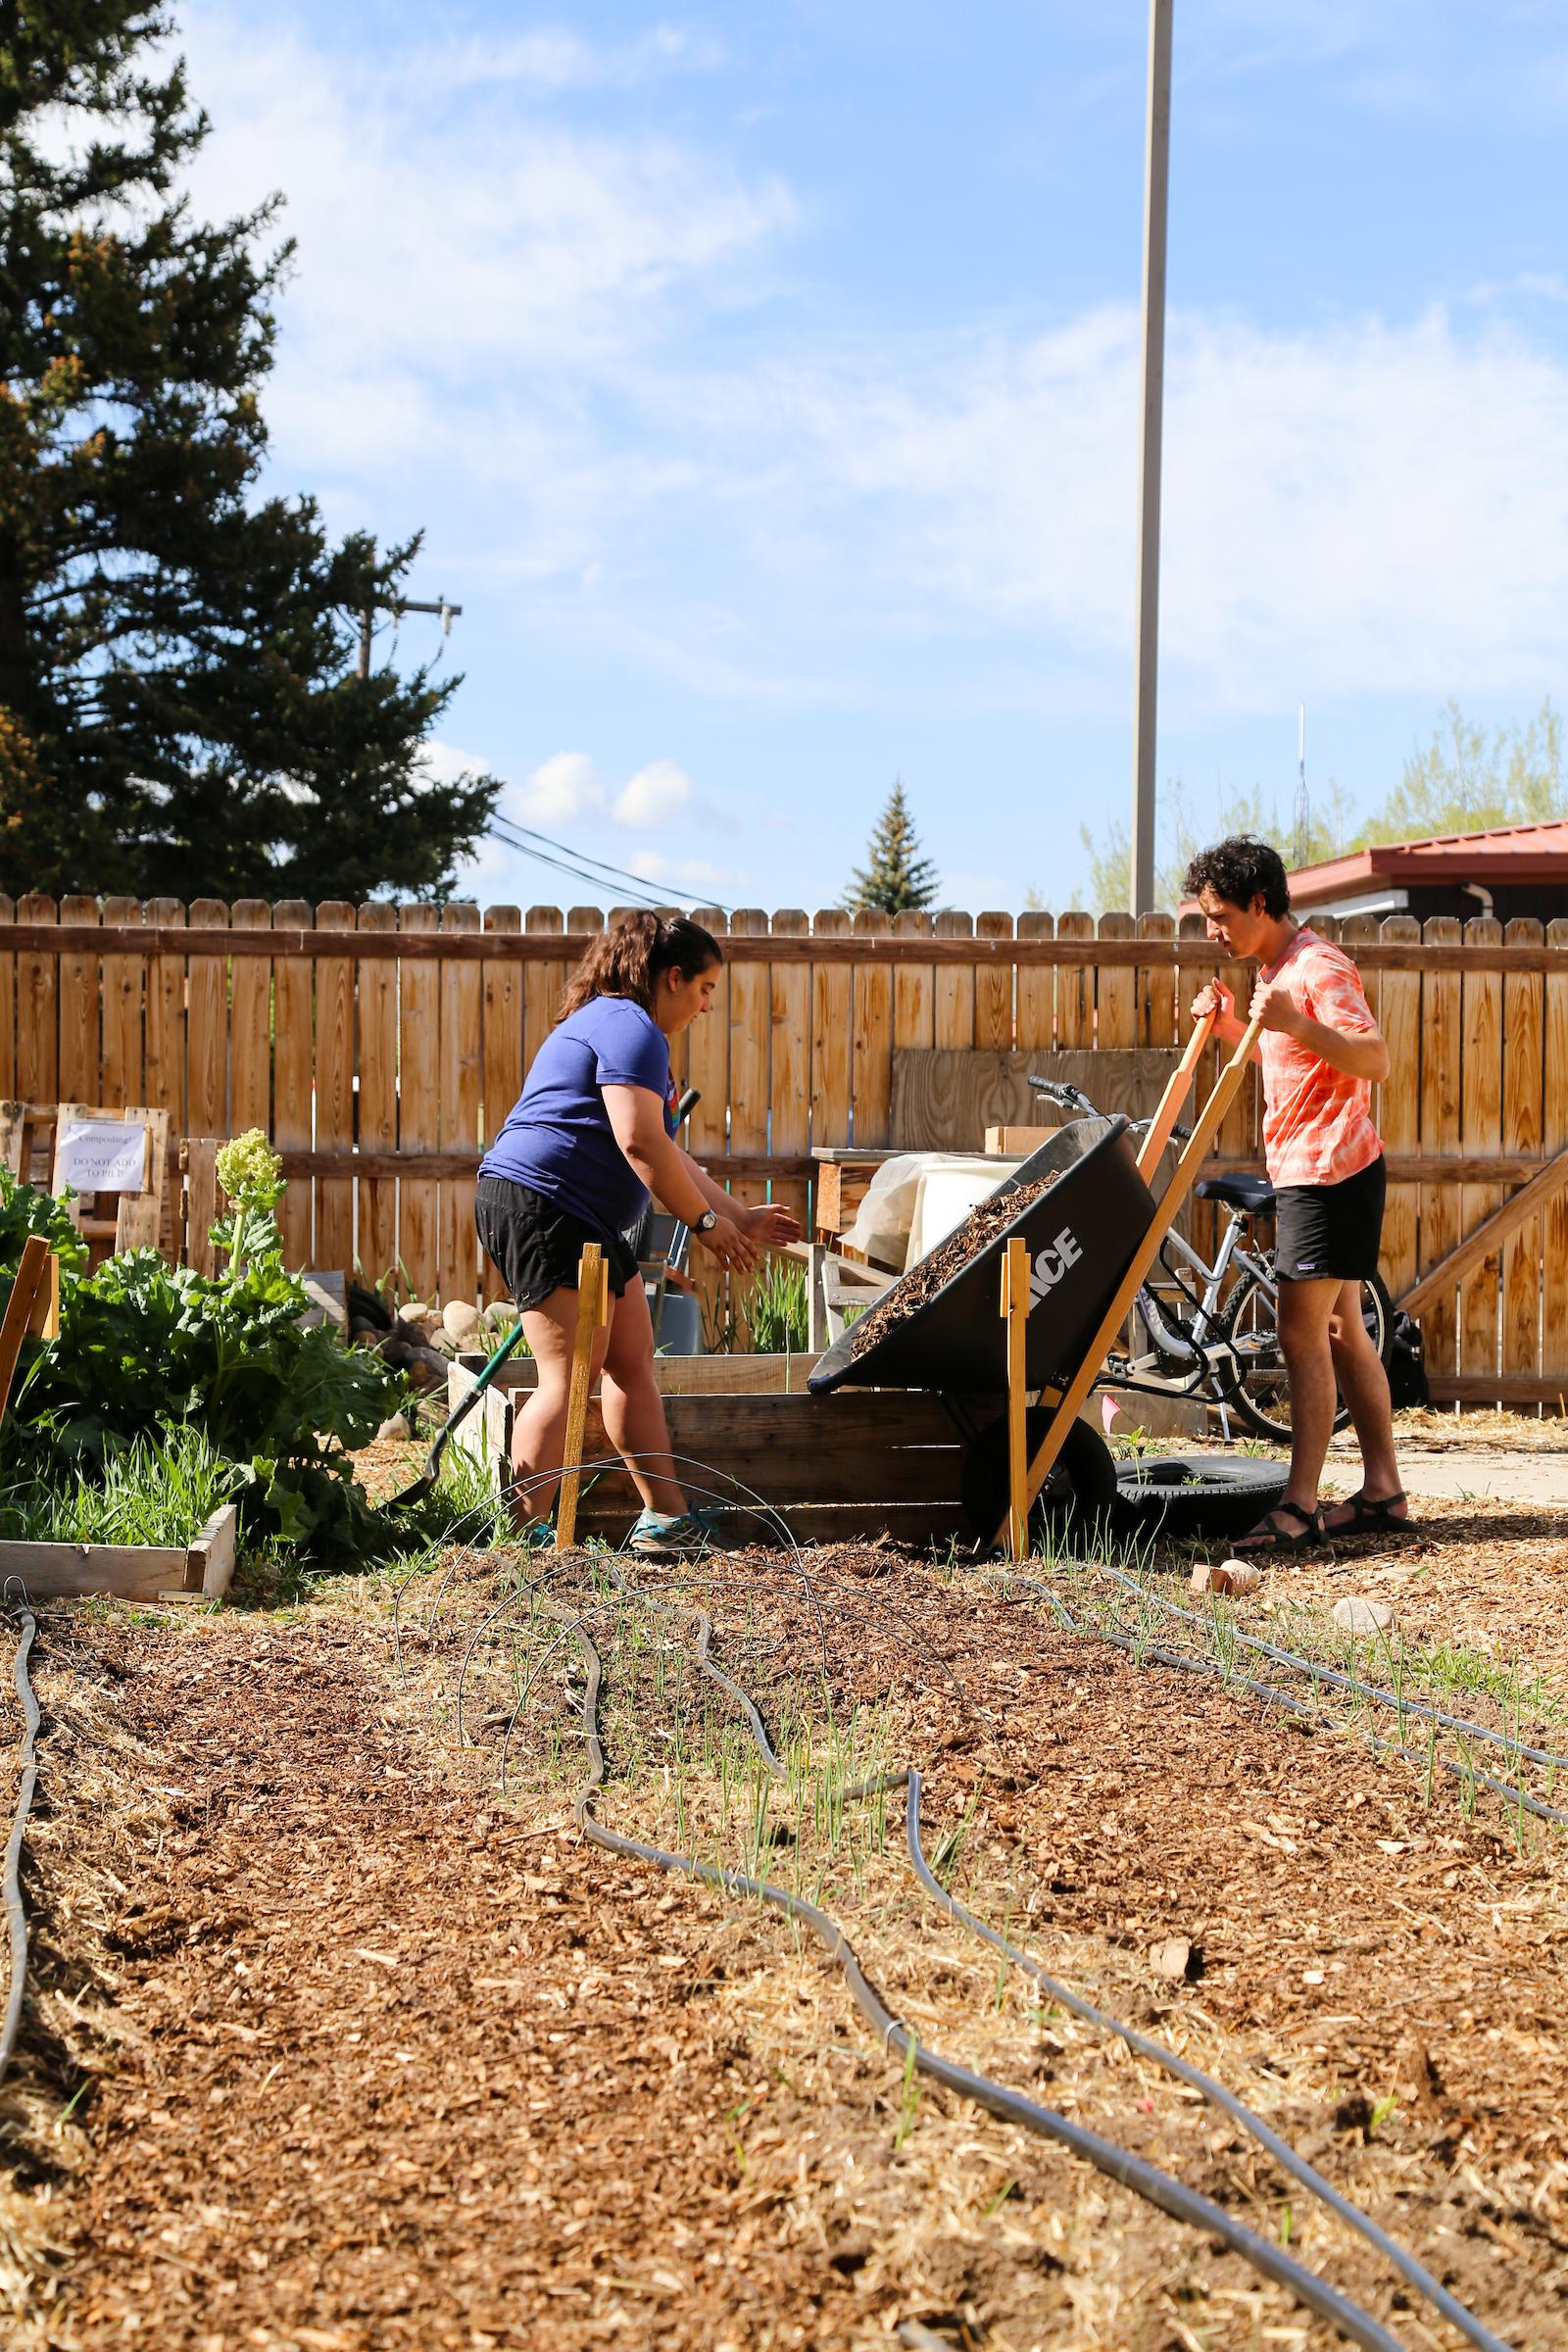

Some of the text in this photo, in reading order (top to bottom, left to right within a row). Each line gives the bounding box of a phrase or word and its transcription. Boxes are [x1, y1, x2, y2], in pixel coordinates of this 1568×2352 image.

[74, 1157, 89, 1166] DO
[91, 1158, 111, 1167] NOT
[86, 1168, 100, 1177] TO
